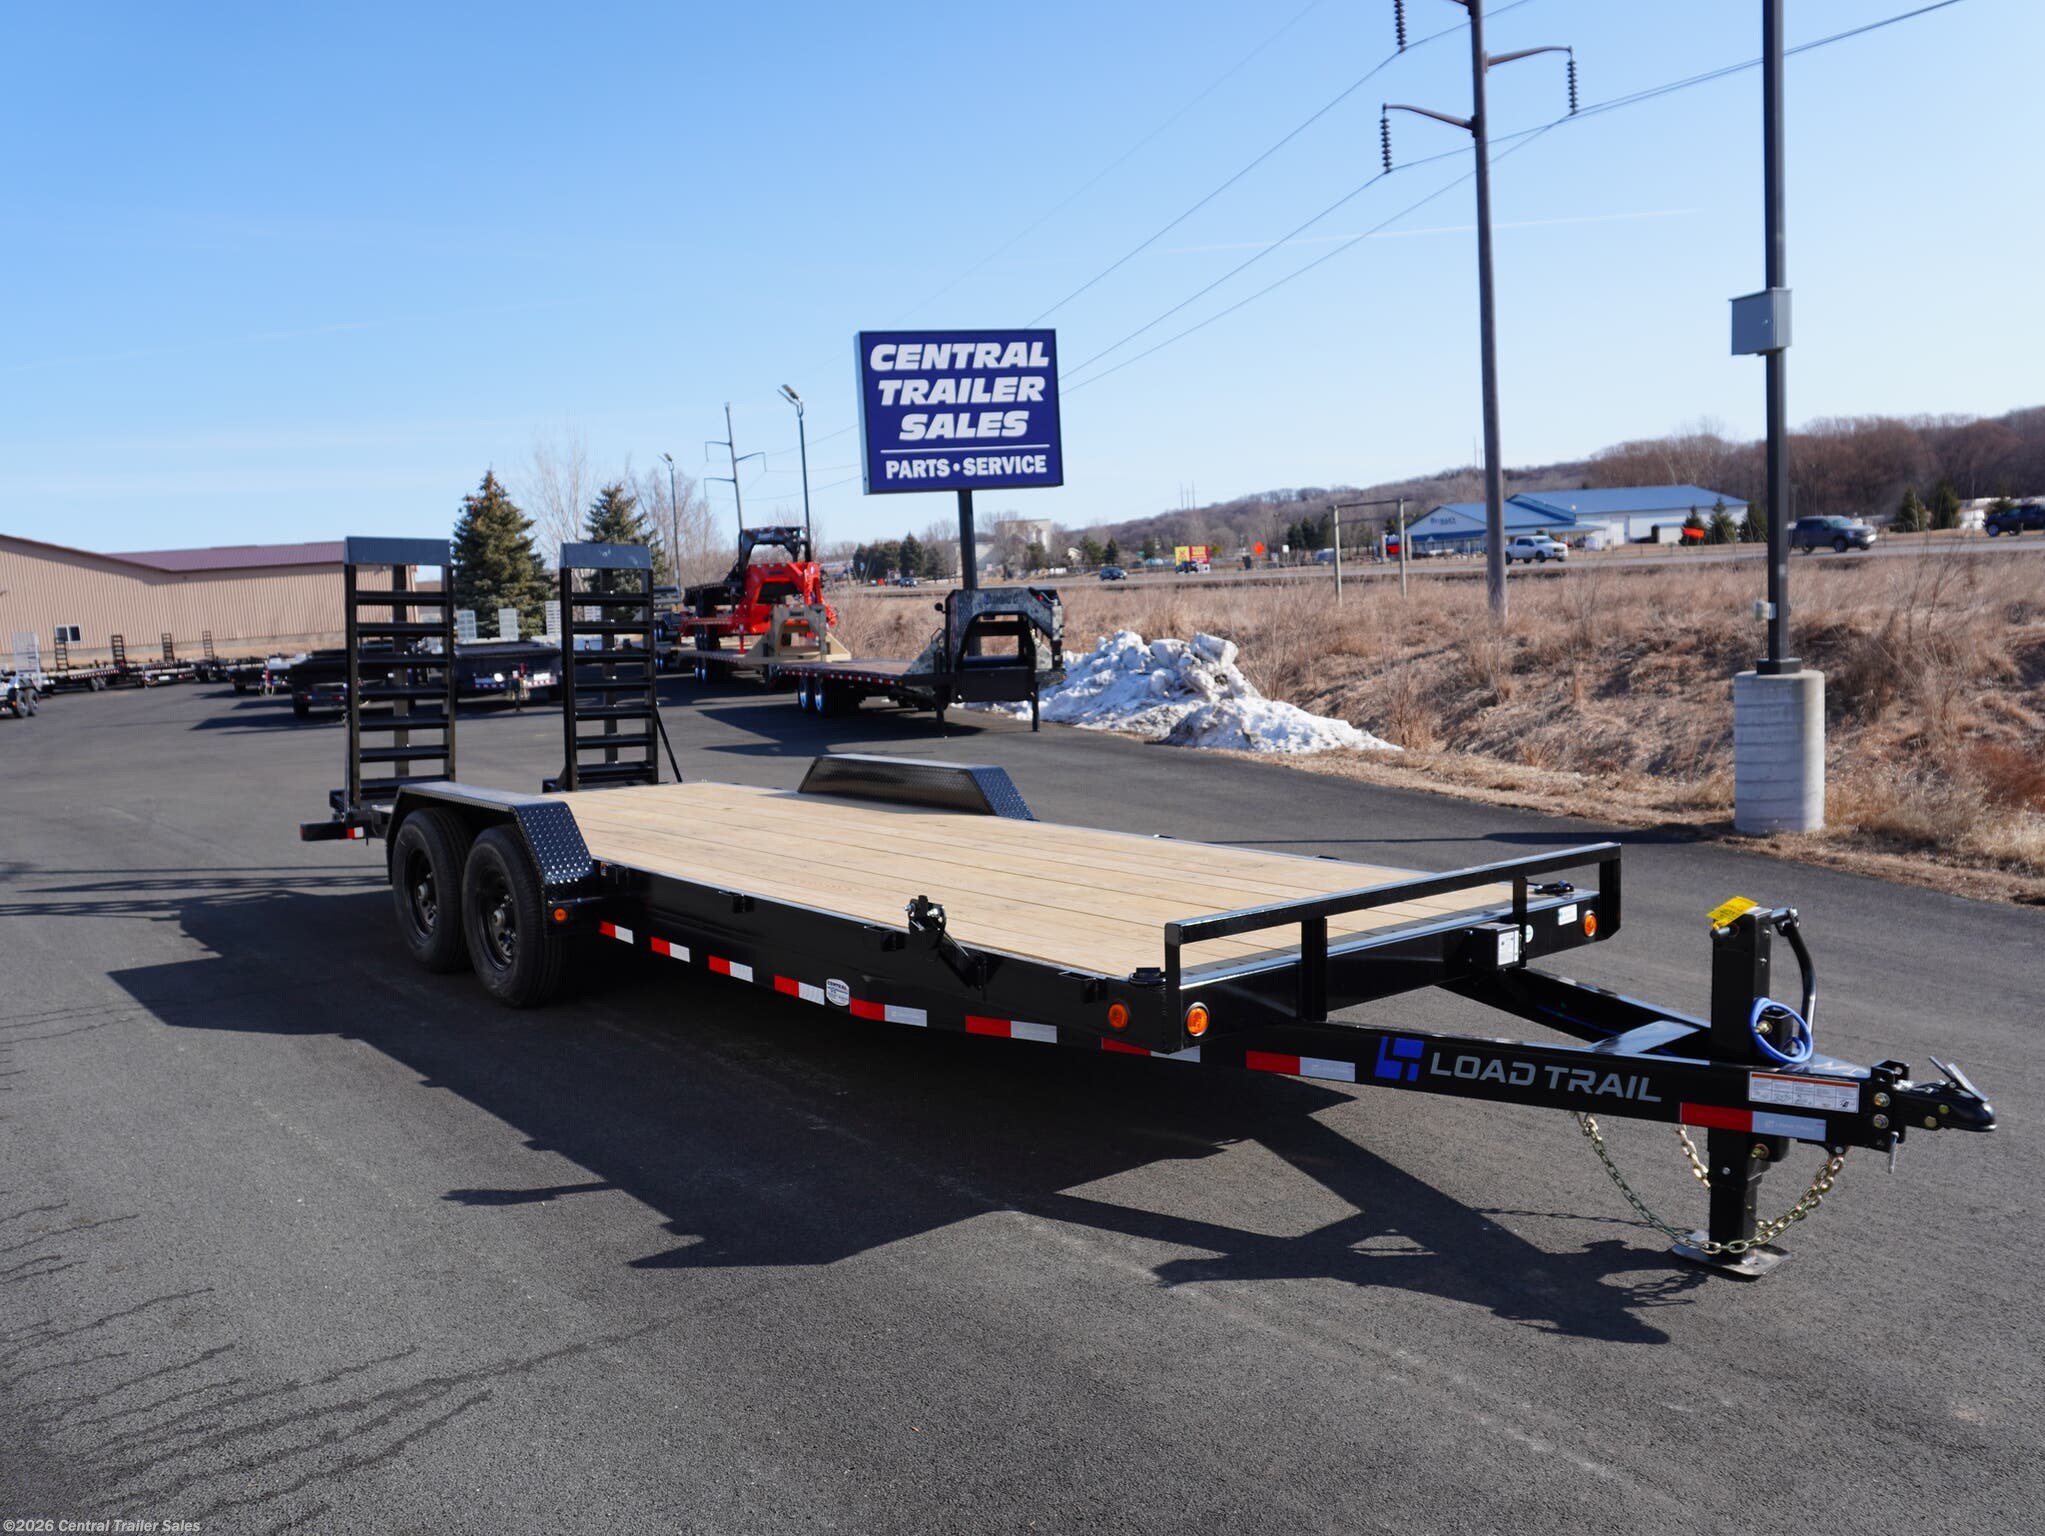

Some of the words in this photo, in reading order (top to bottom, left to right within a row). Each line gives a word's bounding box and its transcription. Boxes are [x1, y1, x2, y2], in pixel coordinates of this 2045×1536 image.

[870, 341, 1049, 371] CENTRAL
[878, 376, 1046, 406] TRAILER
[899, 410, 1029, 441] SALES
[1430, 1052, 1536, 1086] LOAD
[1544, 1065, 1662, 1102] TRAIL
